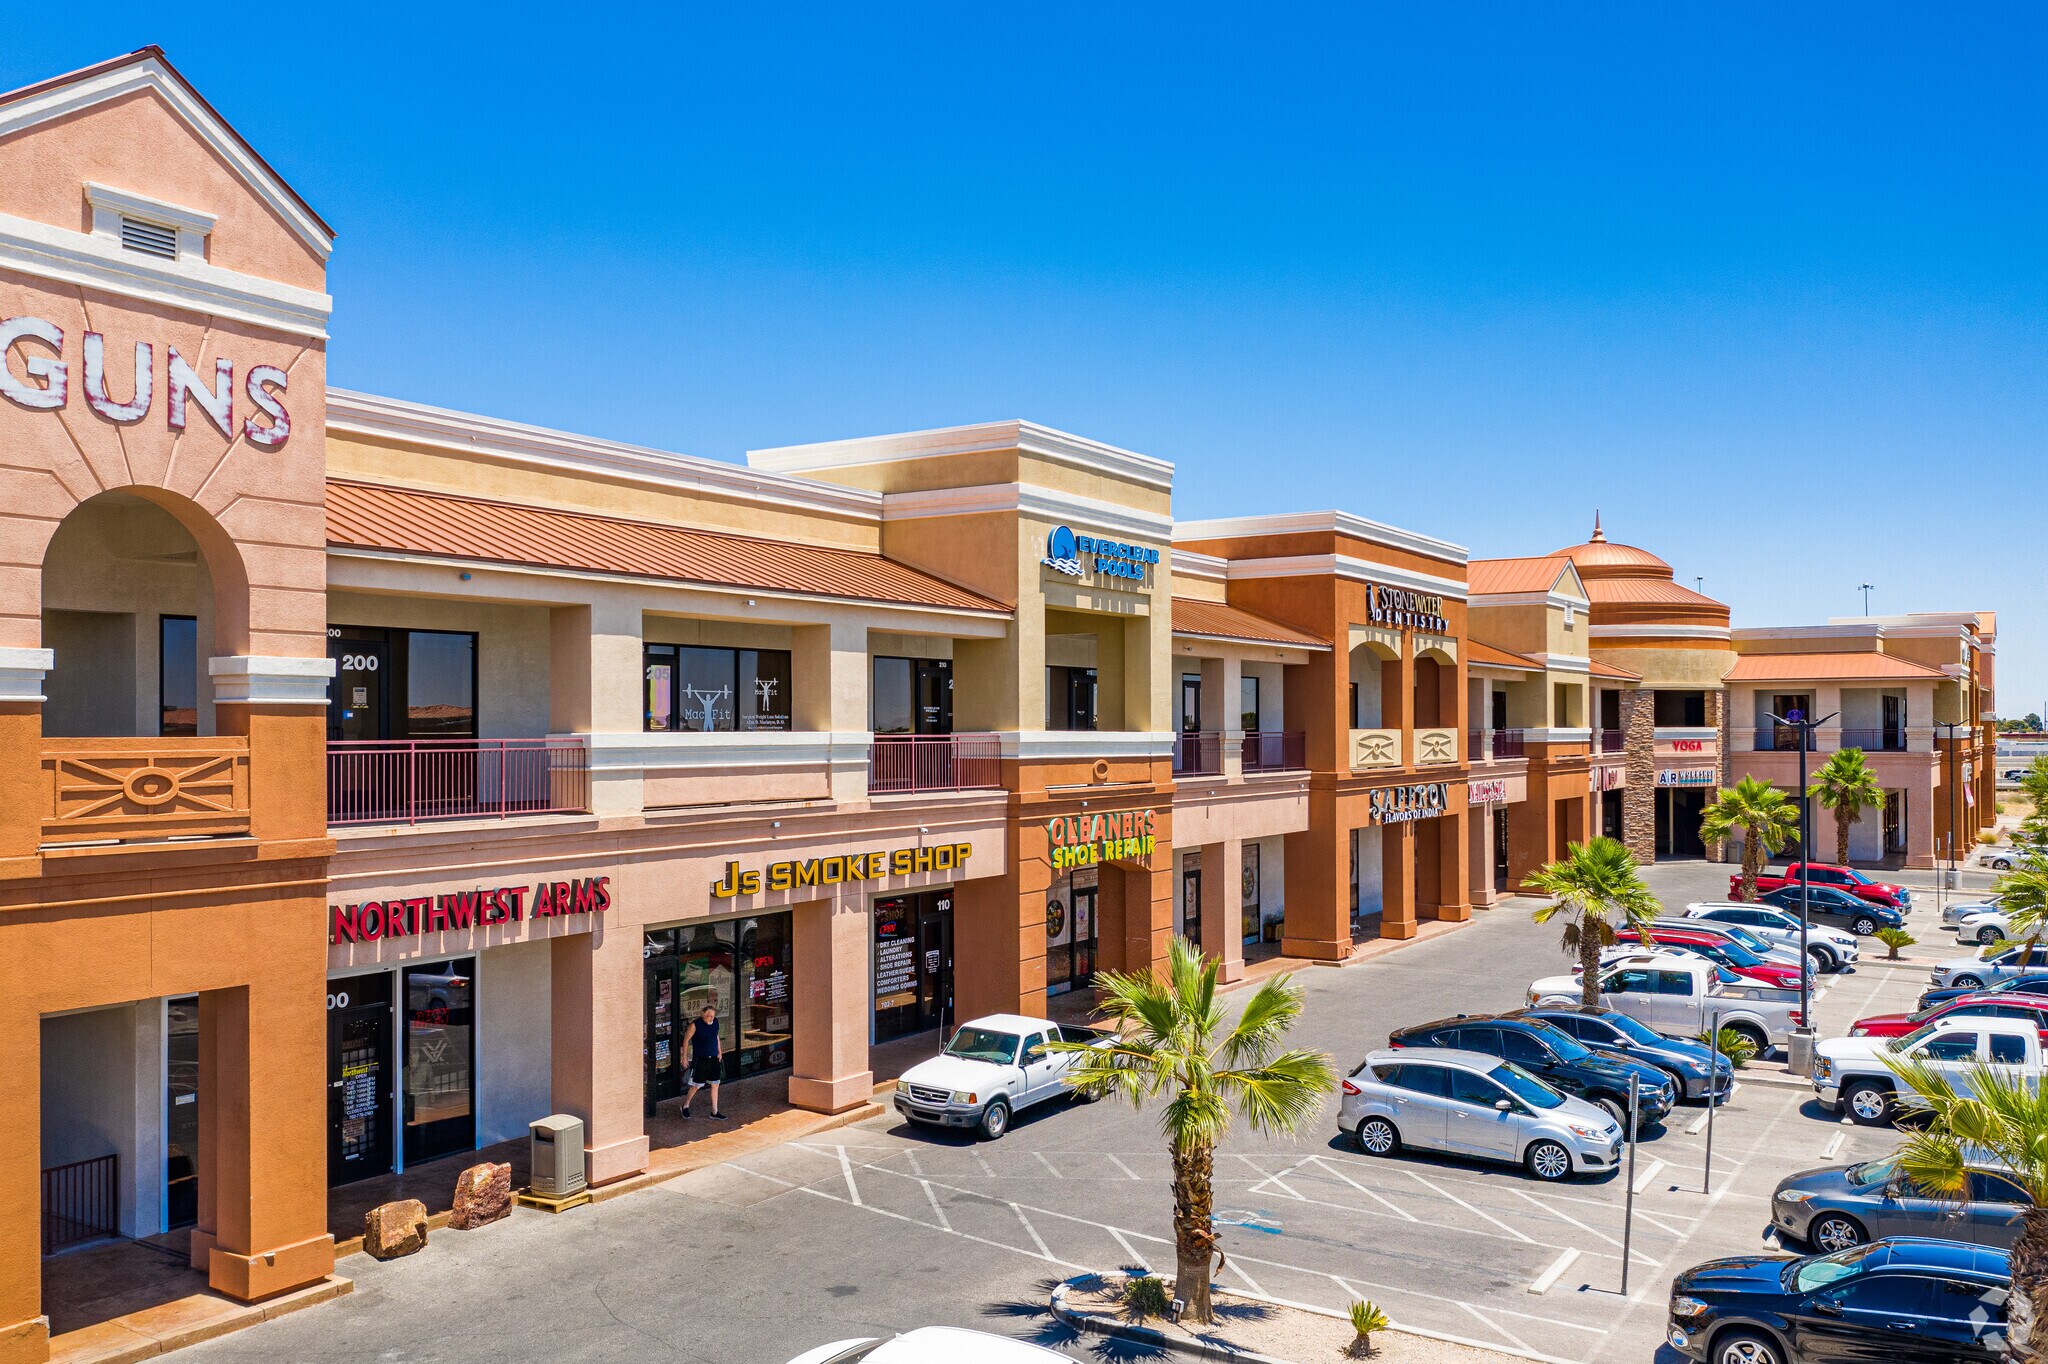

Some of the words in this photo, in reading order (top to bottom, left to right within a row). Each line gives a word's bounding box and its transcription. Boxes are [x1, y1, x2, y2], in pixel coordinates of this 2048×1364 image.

[0, 316, 290, 445] GUNS
[1077, 536, 1160, 564] EVERCLEAR
[1095, 558, 1144, 580] POOLS
[1379, 585, 1444, 620] STONEWATER
[1375, 608, 1449, 631] DENTISTRY
[326, 629, 341, 637] 00
[342, 655, 378, 671] 200
[646, 666, 670, 680] 205
[685, 709, 704, 720] Mac
[712, 709, 730, 719] Fit
[1673, 740, 1702, 752] YOGA
[1369, 783, 1448, 820] SAFFRON
[1384, 811, 1412, 824] FLAVORS
[1413, 811, 1421, 820] OF
[1421, 808, 1439, 818] INDIA
[1049, 810, 1157, 845] CLEANERS
[1052, 843, 1098, 869] SHOE
[1102, 835, 1156, 861] REPAIR
[765, 851, 885, 891] SMOKE
[889, 842, 972, 876] SHOP
[329, 886, 529, 945] NORTHWEST
[529, 876, 611, 919] ARMS
[937, 899, 950, 911] 110
[880, 941, 890, 949] DRY
[891, 937, 915, 946] CLEANING
[880, 946, 902, 955] LAUNDRY
[754, 956, 773, 967] OPEN
[880, 951, 912, 962] ALTERATIONS
[327, 992, 349, 1010] 00
